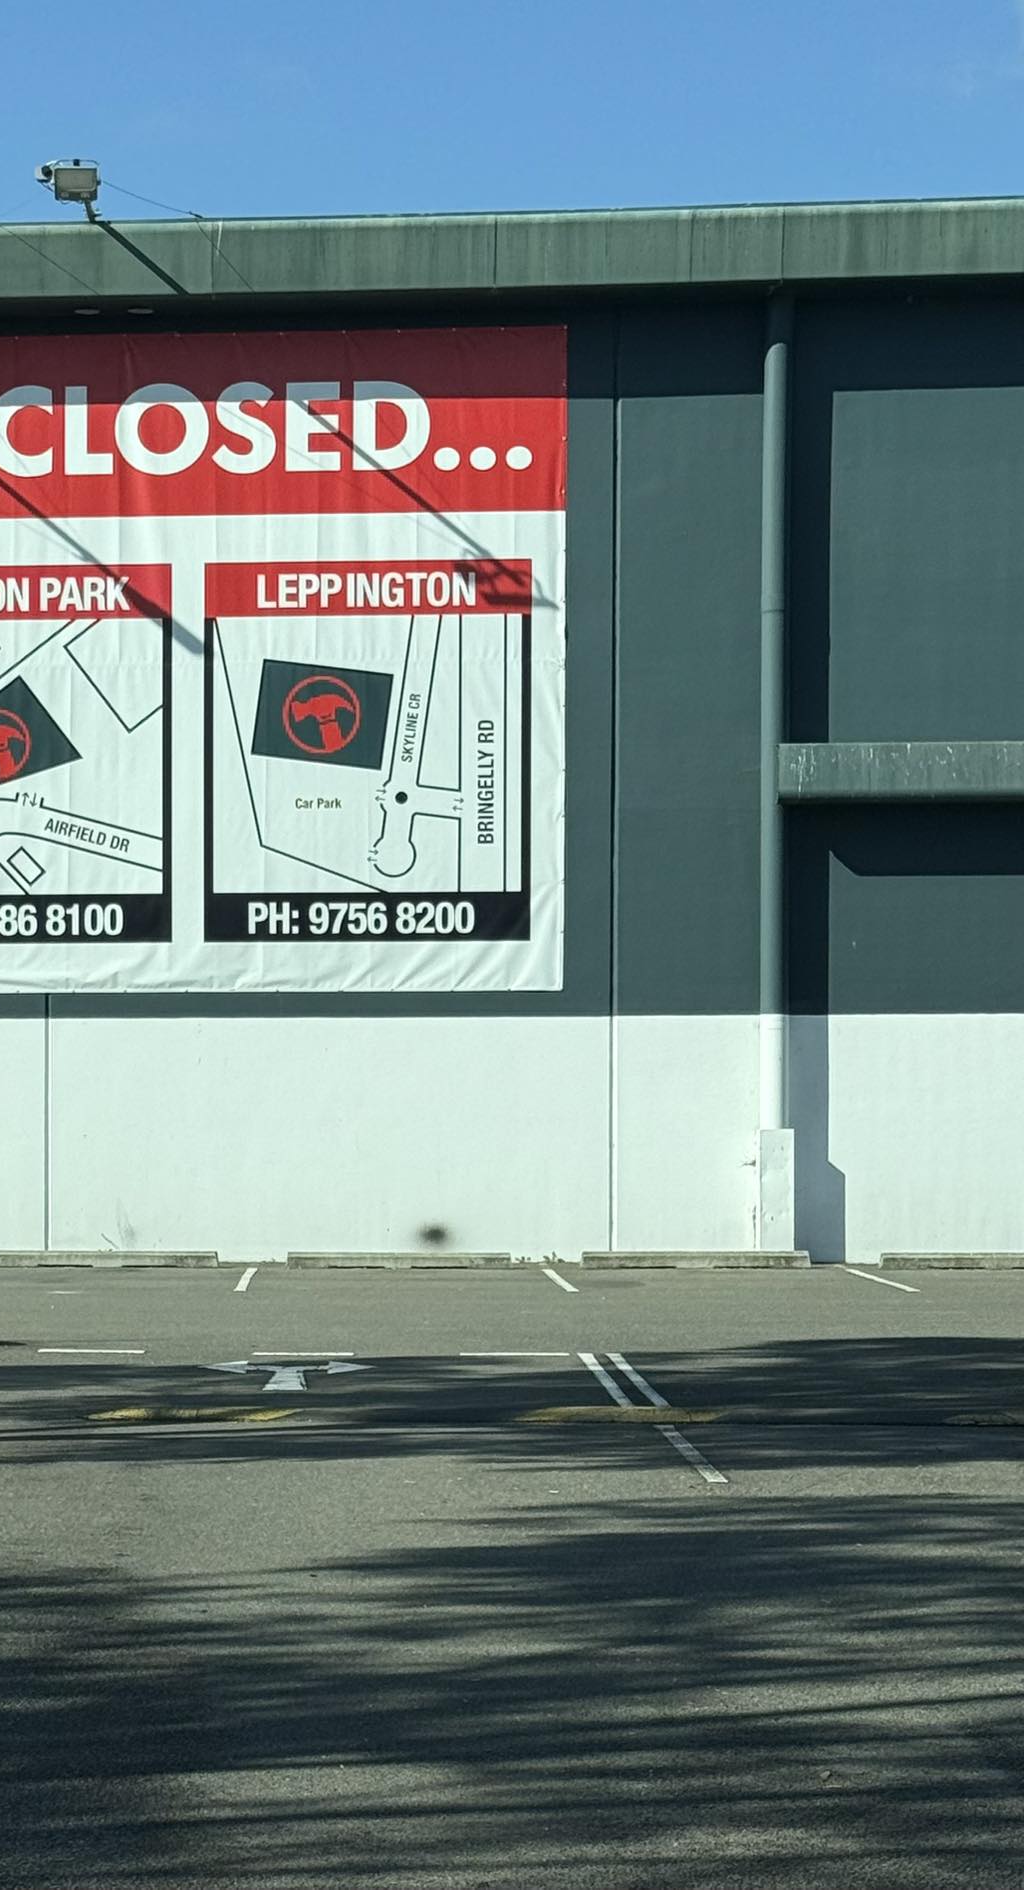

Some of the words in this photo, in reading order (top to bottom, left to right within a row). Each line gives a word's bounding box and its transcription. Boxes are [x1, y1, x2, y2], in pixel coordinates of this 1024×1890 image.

[39, 574, 131, 612] PARK
[257, 570, 476, 608] LEPPINGTON
[408, 692, 422, 711] CR
[401, 713, 419, 763] SKYLINE
[477, 719, 495, 744] RD
[294, 797, 314, 810] Car
[316, 797, 342, 809] Park
[477, 748, 495, 845] BRINGELLY
[44, 817, 107, 847] AIRFIELD
[110, 835, 131, 853] DR
[45, 903, 124, 937] 8100
[247, 901, 300, 935] PH:
[308, 901, 388, 935] 9756
[395, 901, 476, 935] 8200
